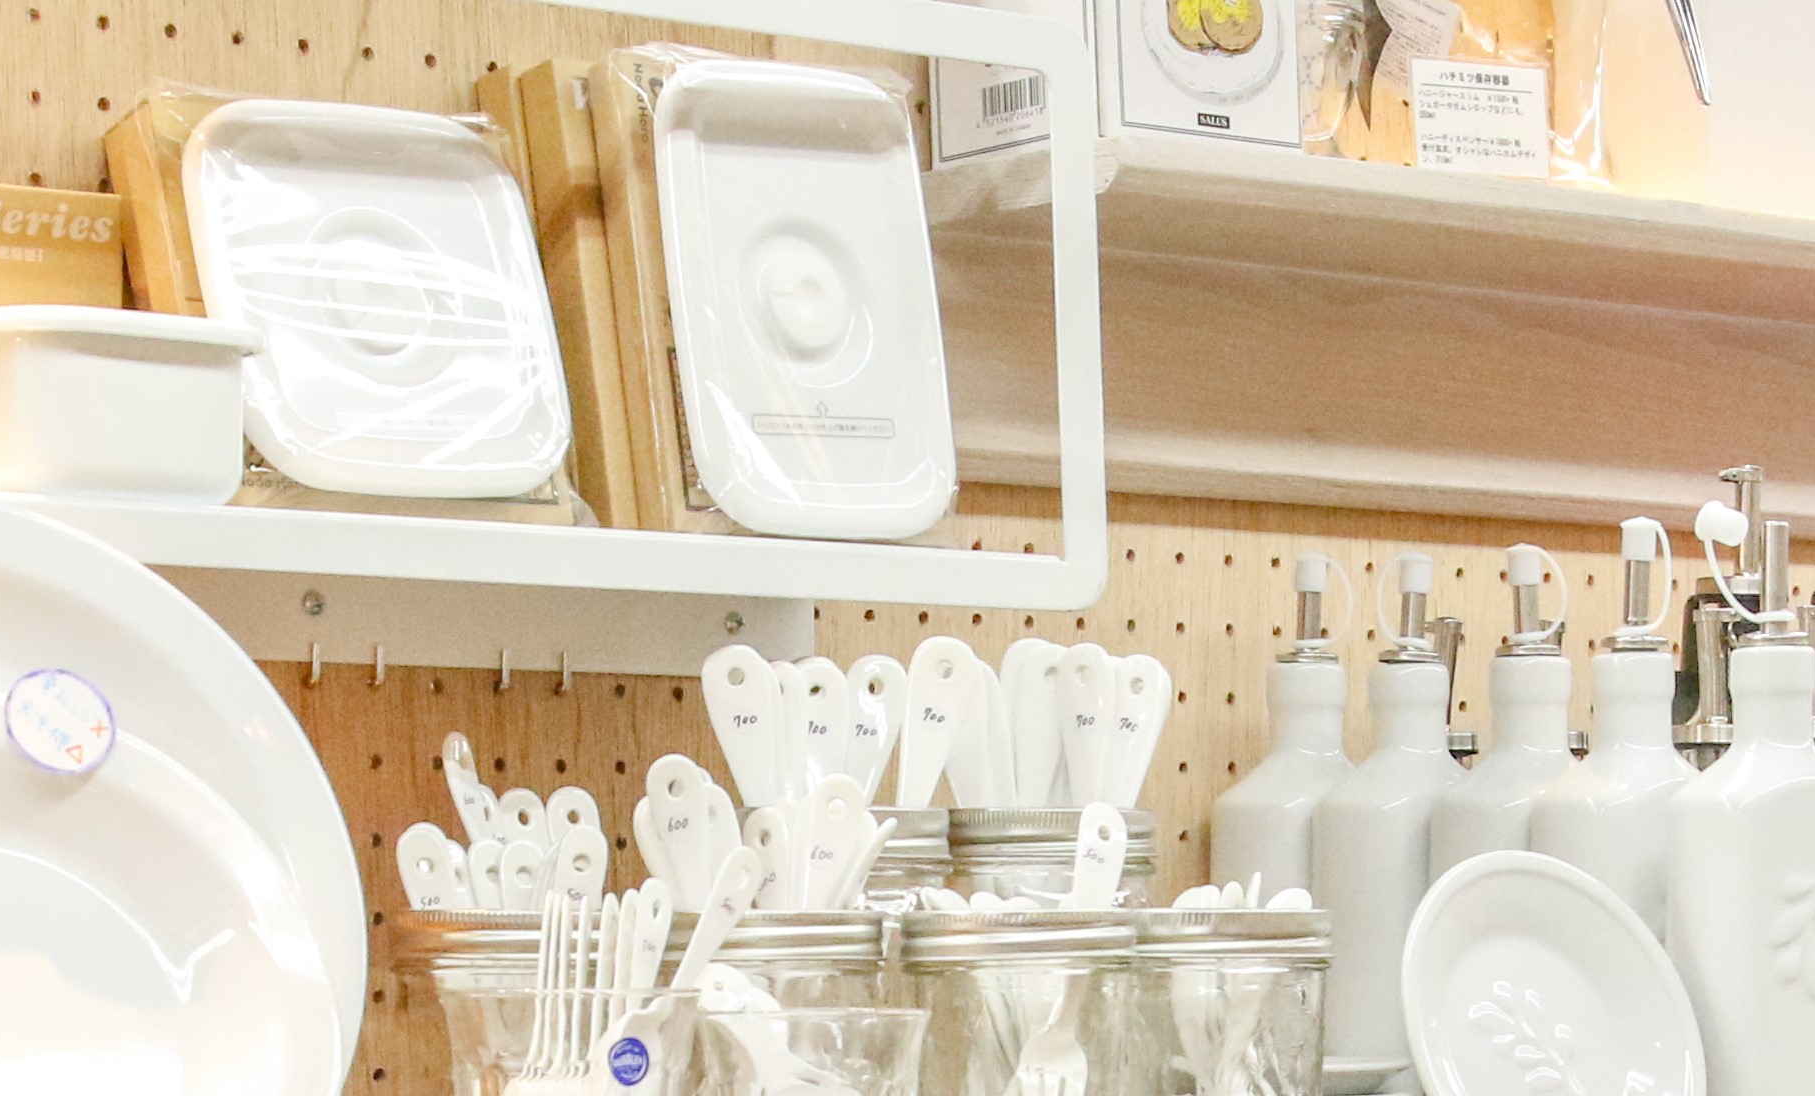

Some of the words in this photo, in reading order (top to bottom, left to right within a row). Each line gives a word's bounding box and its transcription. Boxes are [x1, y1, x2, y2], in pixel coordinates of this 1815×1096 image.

[1199, 114, 1230, 128] SALUS
[733, 713, 758, 729] 700
[923, 707, 946, 724] 700
[1076, 714, 1096, 728] 700
[854, 723, 878, 738] 700
[667, 817, 690, 833] 600
[810, 845, 834, 862] 600
[1083, 847, 1106, 865] 500
